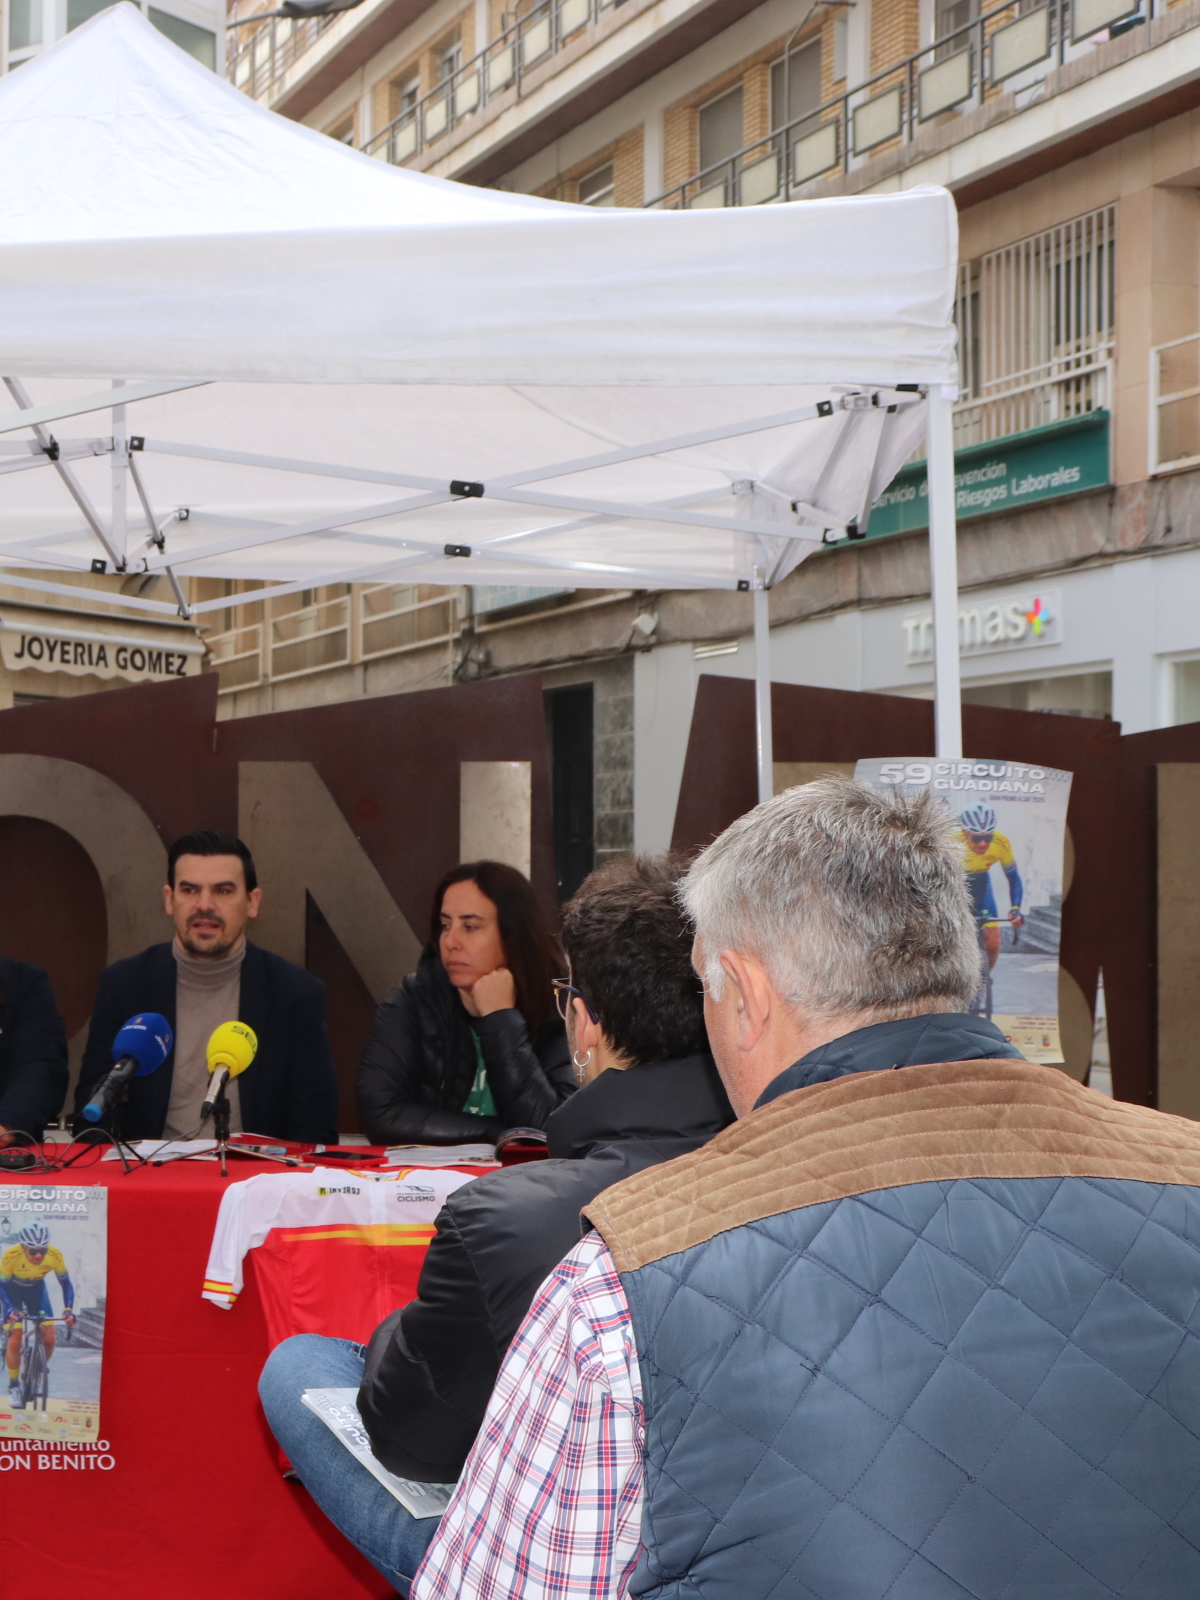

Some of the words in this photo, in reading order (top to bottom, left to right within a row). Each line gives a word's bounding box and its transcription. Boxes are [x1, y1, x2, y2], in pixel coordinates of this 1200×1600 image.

[956, 483, 1008, 509] Riesgos
[1011, 466, 1081, 497] Laborales
[902, 601, 1028, 653] Trmas
[14, 634, 109, 669] JOYERIA
[115, 647, 188, 677] GOMEZ
[878, 763, 932, 785] 59
[934, 762, 1048, 780] CIRCUITO
[934, 777, 1046, 794] GUADIANA
[397, 1195, 436, 1203] CICLISMO
[37, 1453, 116, 1471] BENITO
